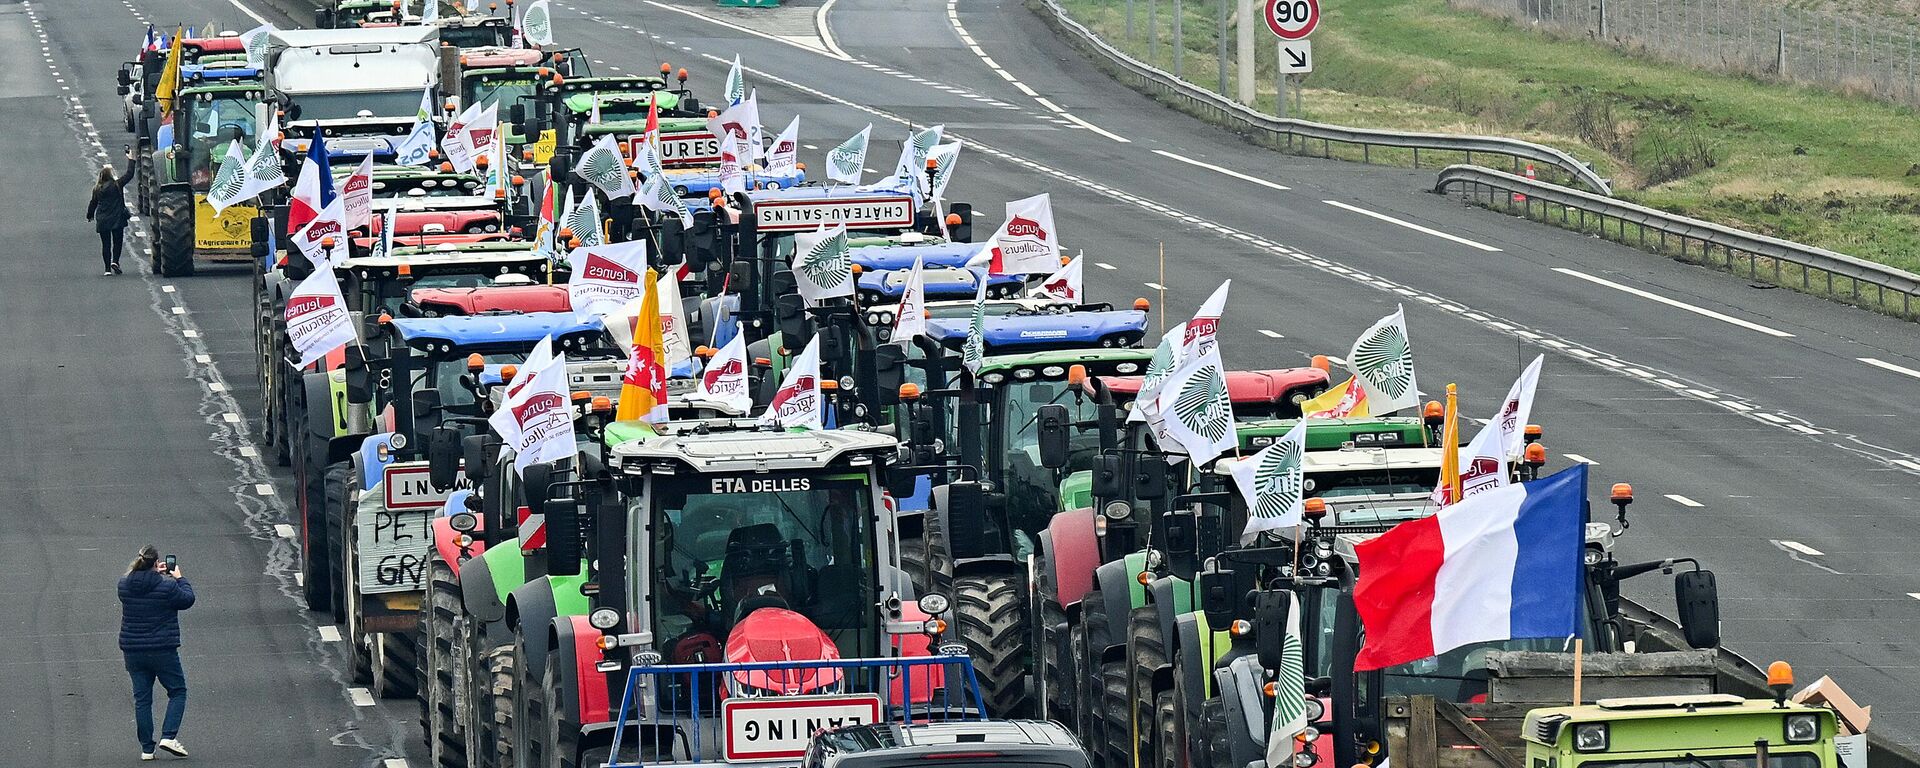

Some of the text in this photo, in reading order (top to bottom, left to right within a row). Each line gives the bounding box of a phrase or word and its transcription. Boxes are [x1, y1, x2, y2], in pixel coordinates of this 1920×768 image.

[1276, 1, 1308, 23] 90
[662, 140, 719, 157] URES
[763, 206, 903, 222] CHÂTEAU-SALINS
[711, 478, 810, 494] ETA DELLES
